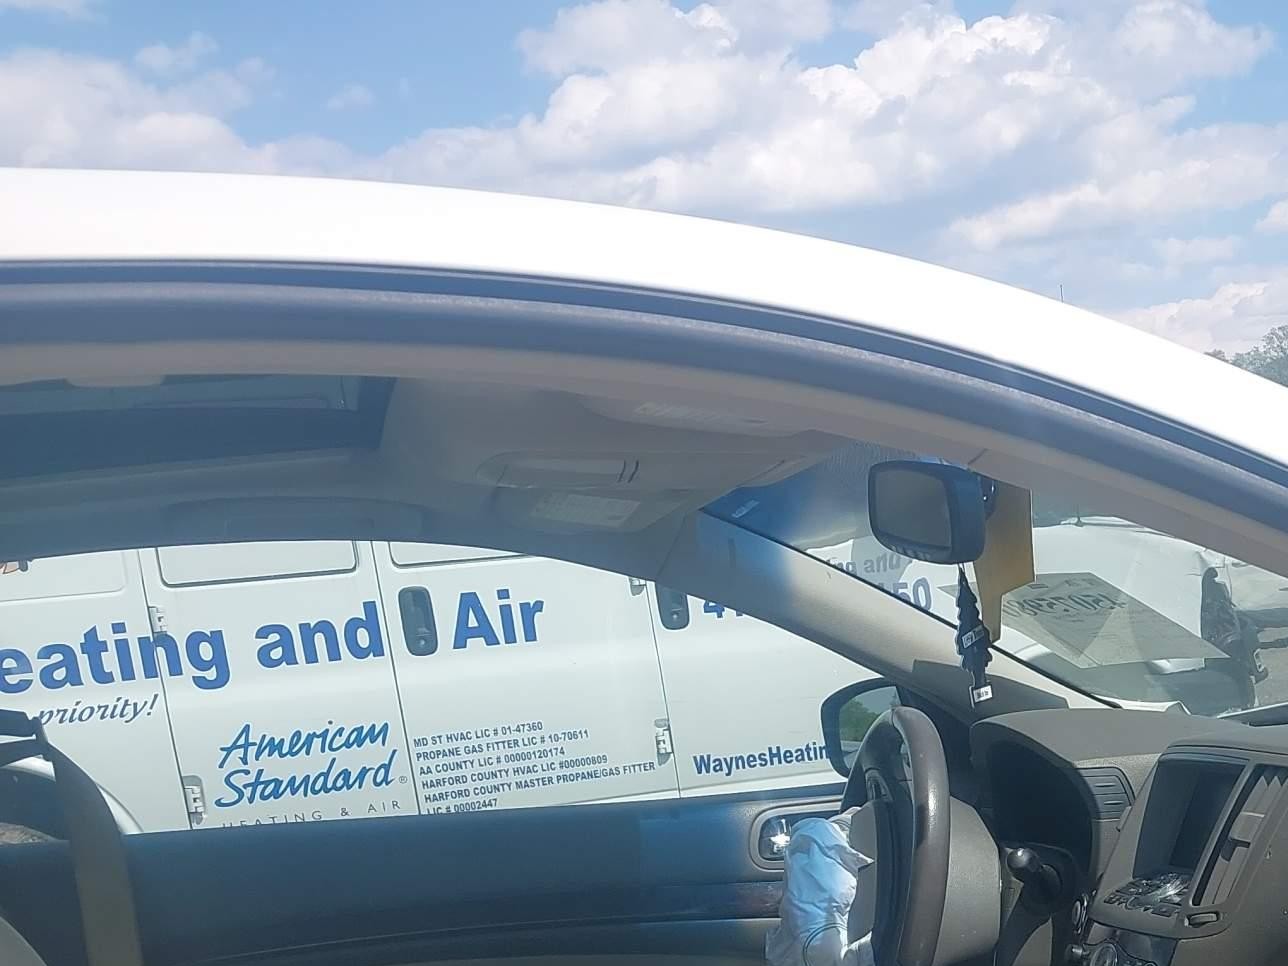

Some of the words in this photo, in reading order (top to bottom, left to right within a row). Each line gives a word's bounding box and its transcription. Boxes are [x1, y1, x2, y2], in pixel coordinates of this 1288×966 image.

[254, 601, 386, 668] and
[453, 588, 544, 649] Air
[40, 693, 159, 726] priority!
[218, 720, 389, 768] American
[413, 737, 429, 748] MD
[430, 735, 443, 746] ST
[446, 731, 472, 743] HVAC
[475, 728, 491, 739] LIC
[493, 727, 499, 737] #
[501, 721, 544, 736] 01-47360
[416, 746, 461, 762] PROPANE
[463, 743, 484, 755] GAS
[486, 739, 520, 752] FITTER
[521, 736, 538, 748] LIC
[540, 735, 546, 745] #
[548, 729, 589, 744] 10-70611
[419, 766, 433, 777] AA
[435, 759, 475, 774] COUNTY
[477, 756, 494, 768] LIC
[496, 755, 502, 765] #
[504, 746, 565, 764] 00000120174
[422, 774, 468, 790] HARFORD
[470, 768, 510, 783] COUNTY
[513, 764, 539, 777] HVAC
[541, 762, 556, 773] LIC
[214, 749, 398, 808] Standard
[424, 788, 471, 804] HARFORD
[473, 782, 512, 797] COUNTY
[515, 775, 554, 790] MASTER
[556, 766, 621, 785] PROPANE/GAS
[623, 761, 656, 775] FITTER
[340, 807, 351, 817] &
[367, 800, 401, 814] AIR
[426, 806, 443, 815] LIC
[453, 798, 498, 813] 00002447
